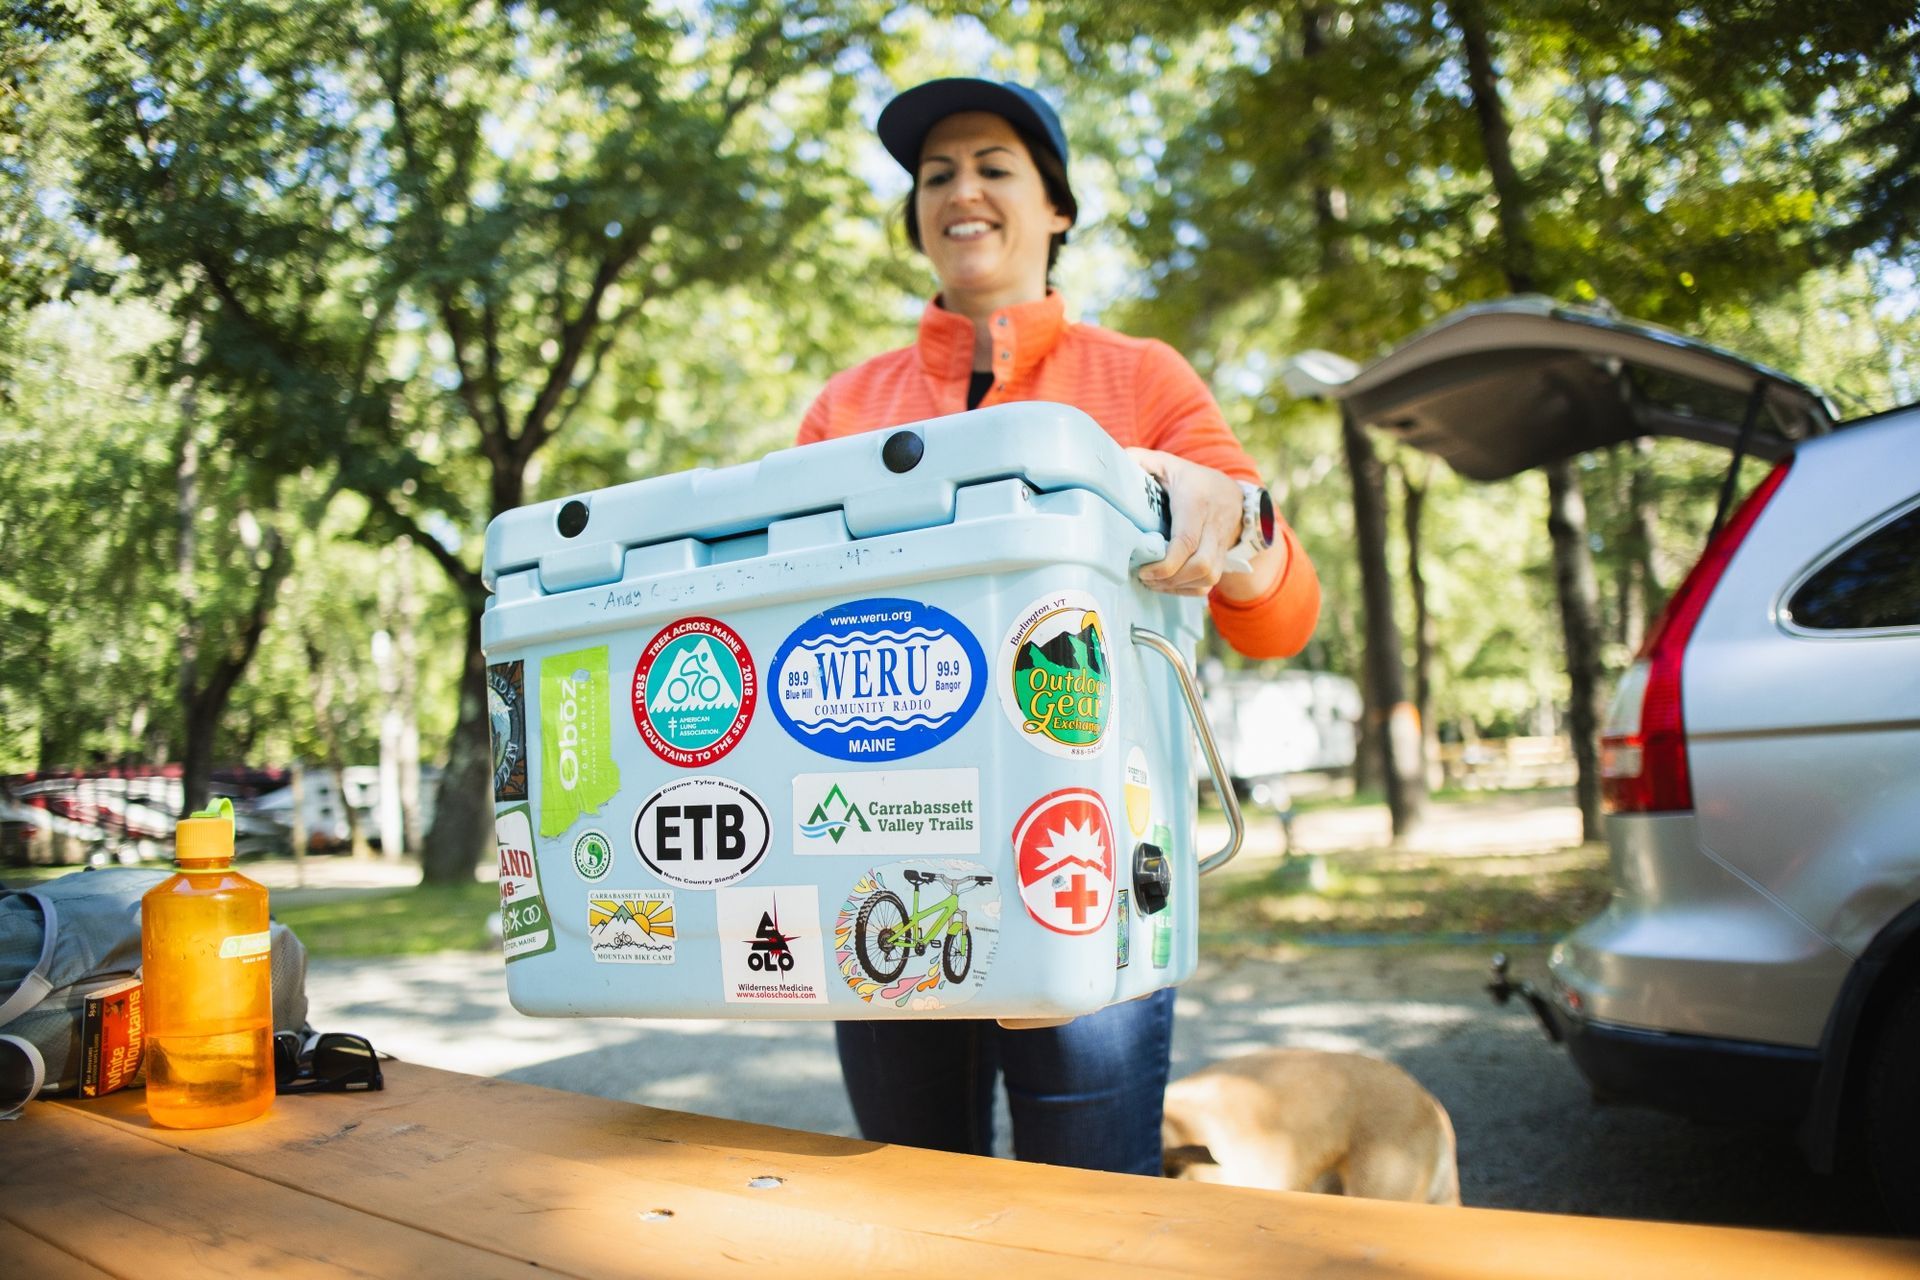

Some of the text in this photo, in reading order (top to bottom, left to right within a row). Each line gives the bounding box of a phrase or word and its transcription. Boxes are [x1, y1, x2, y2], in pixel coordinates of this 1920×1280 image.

[604, 589, 642, 610] Andy
[1054, 598, 1066, 608] VT
[830, 610, 912, 626] www.weru.org
[648, 622, 742, 656] TREK ACROSS MAINE
[814, 645, 930, 700] WERU
[937, 660, 960, 676] 99.9
[742, 664, 753, 696] 2018
[788, 670, 809, 686] 89.9
[936, 680, 961, 692] Bangor
[636, 673, 646, 704] 1985
[786, 688, 812, 700] Blue Hill
[814, 699, 932, 716] COMMUNITY RADIO
[1054, 717, 1102, 735] Exchang
[640, 714, 748, 763] MOUNTAINS TO THE SEA
[848, 738, 896, 753] MAINE
[662, 782, 692, 794] Eugene
[718, 781, 739, 792] Band
[868, 800, 973, 816] Carrabassett
[656, 804, 746, 860] ETB
[878, 818, 974, 834] Valley Trails
[580, 862, 606, 874] BIKE SHOP
[664, 872, 682, 883] North
[518, 936, 536, 946] MAINE
[738, 984, 778, 992] Wilderness
[107, 1046, 125, 1090] White
